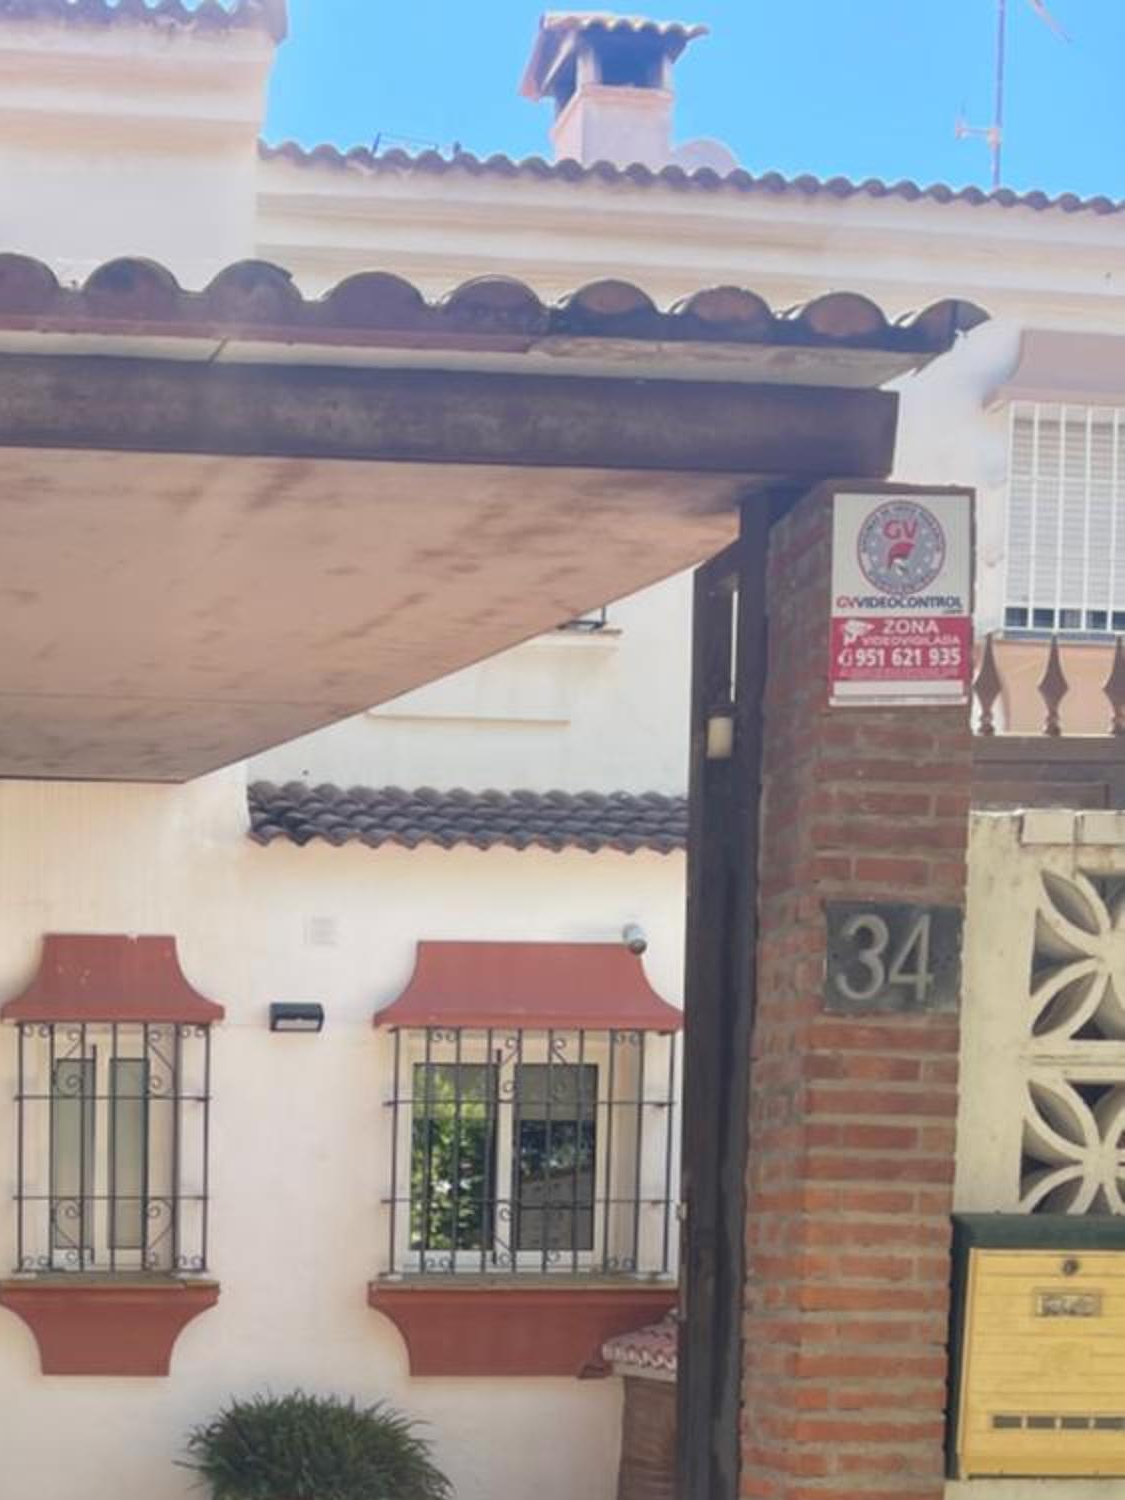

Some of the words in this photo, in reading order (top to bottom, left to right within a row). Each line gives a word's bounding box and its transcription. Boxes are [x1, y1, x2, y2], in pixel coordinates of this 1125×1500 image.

[883, 519, 918, 539] GV
[836, 595, 963, 609] GVVIDEOCONTROL
[882, 619, 940, 635] ZONA
[855, 648, 885, 667] 951
[891, 648, 922, 667] 621
[928, 647, 962, 666] 935
[834, 913, 935, 1001] 34
